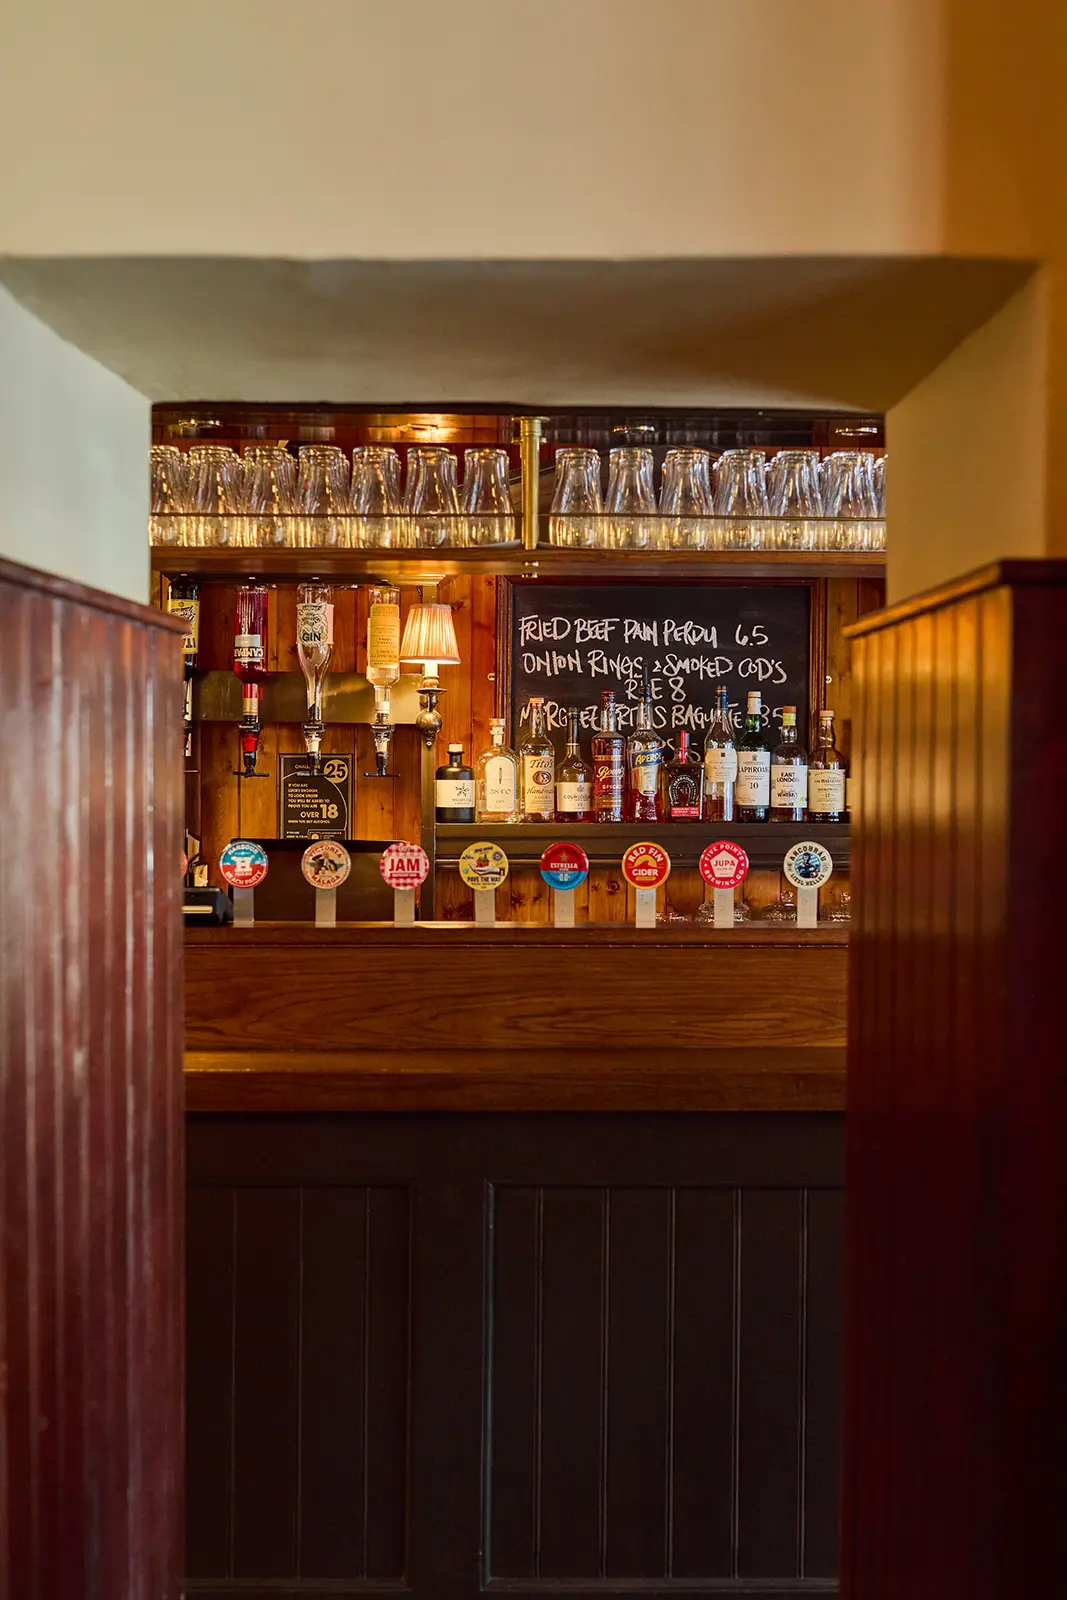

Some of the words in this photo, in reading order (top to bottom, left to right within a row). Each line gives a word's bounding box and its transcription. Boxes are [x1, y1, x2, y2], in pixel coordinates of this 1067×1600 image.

[302, 632, 321, 642] GIN
[519, 615, 571, 647] FRIED
[574, 618, 620, 643] BEEF
[623, 618, 659, 647] PAIN
[735, 624, 769, 646] 6.5
[522, 649, 583, 677] ONION
[587, 649, 643, 680] RINGS
[662, 653, 734, 681] SMOKED
[738, 657, 788, 684] COD'S
[624, 677, 663, 700] RE
[668, 676, 687, 702] 8
[519, 701, 601, 732] MRGEZ
[326, 764, 346, 778] 25
[320, 804, 338, 819] 18
[310, 845, 342, 858] VICTORIA
[628, 846, 646, 862] RED
[648, 847, 664, 862] FIN
[704, 846, 718, 861] FIVE
[720, 844, 744, 860] POINTS
[388, 858, 420, 872] JAM
[632, 868, 659, 876] CIDER
[225, 871, 244, 886] BEACH
[244, 870, 262, 885] PARTY
[704, 870, 736, 886] BREWING
[736, 870, 744, 880] CO
